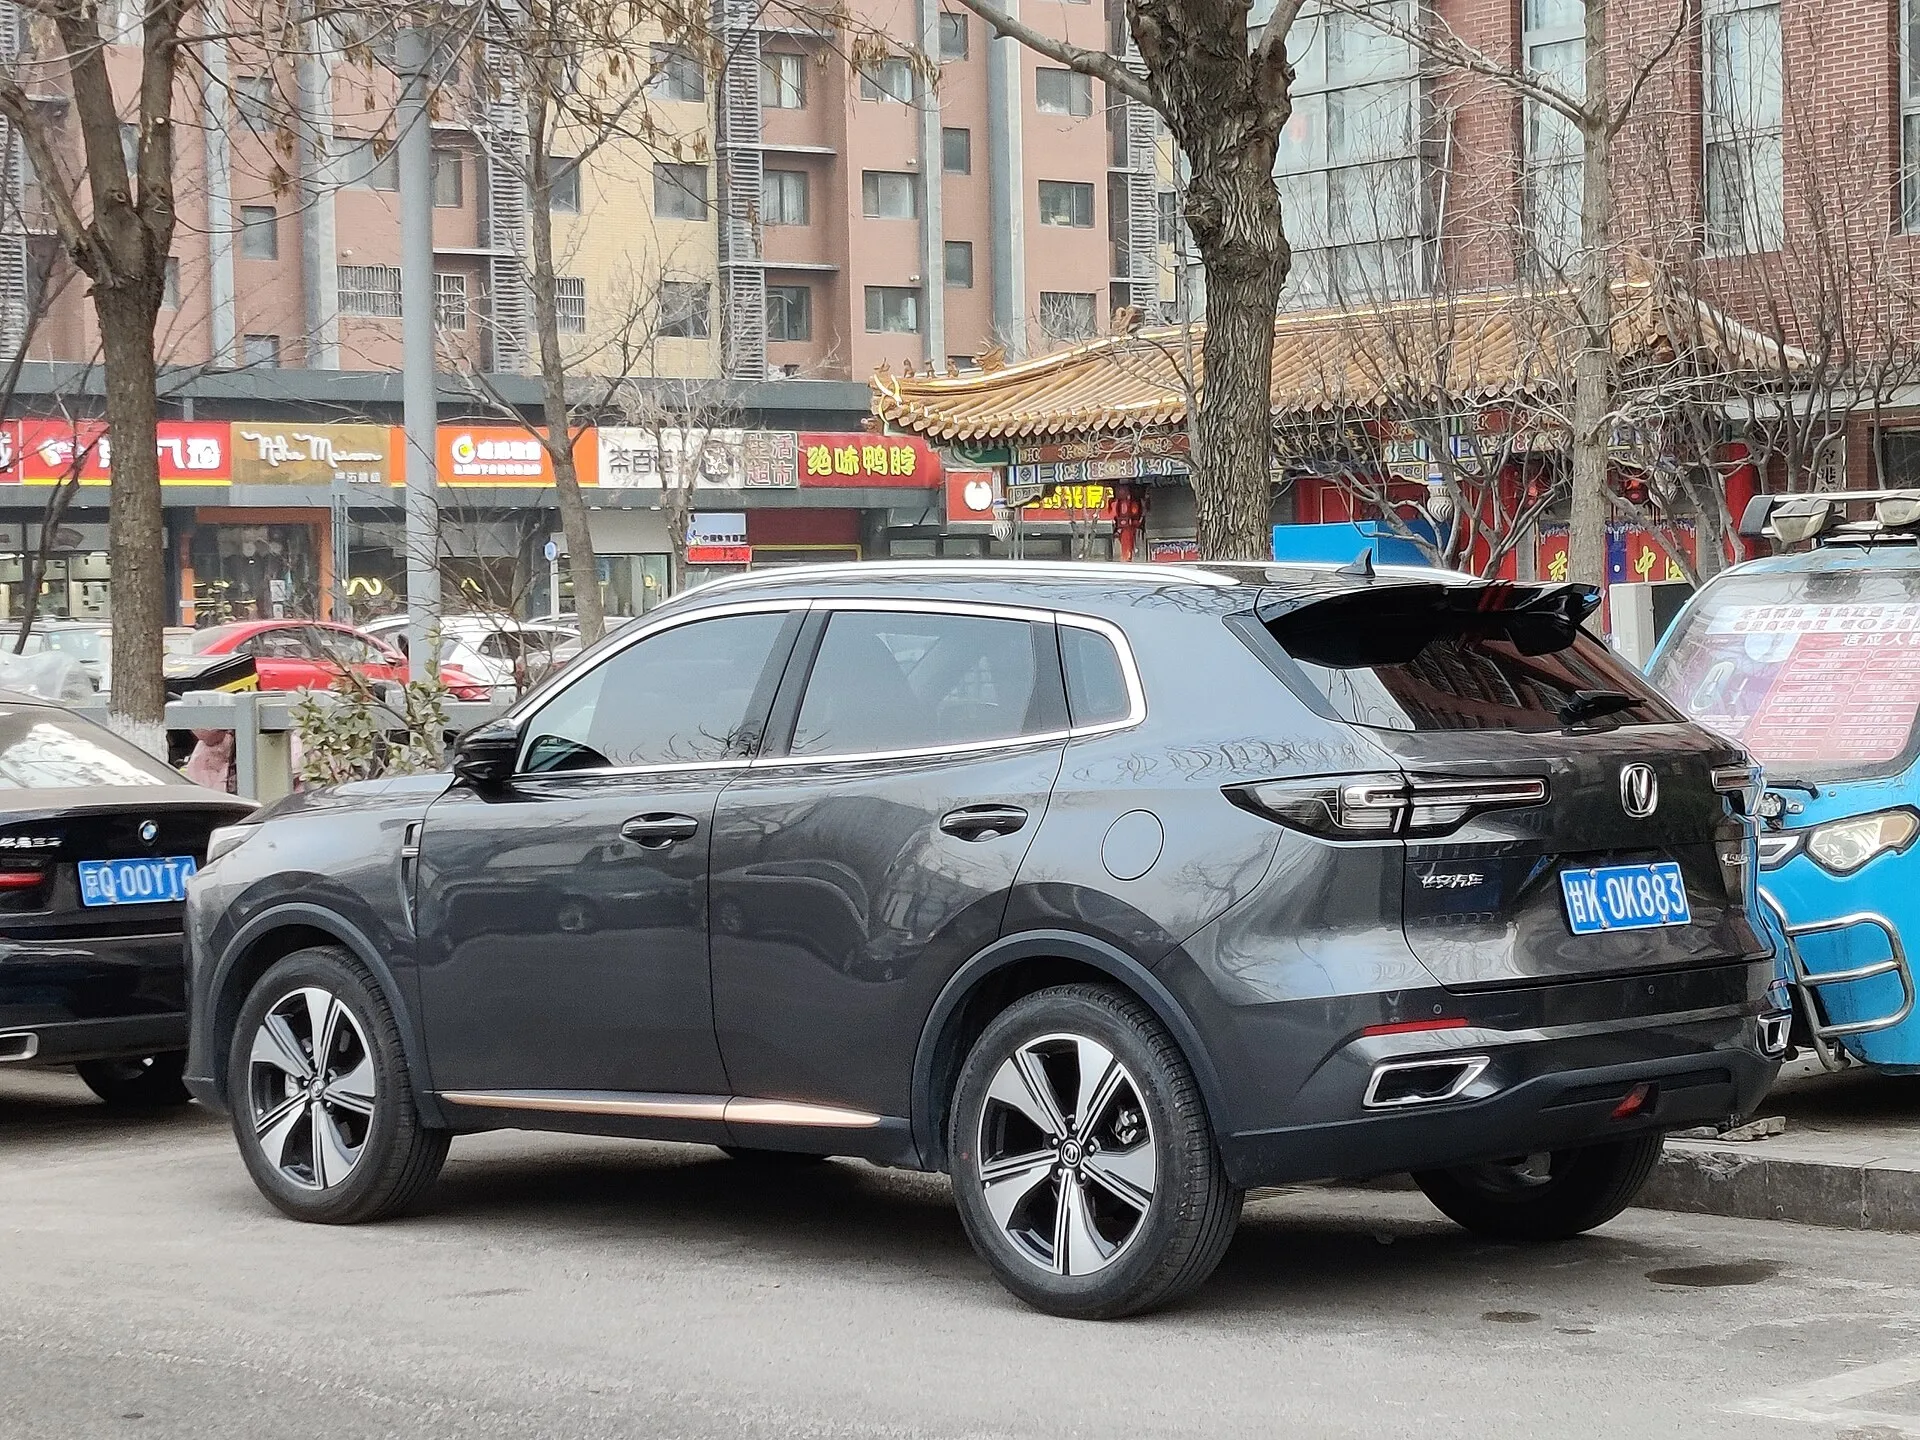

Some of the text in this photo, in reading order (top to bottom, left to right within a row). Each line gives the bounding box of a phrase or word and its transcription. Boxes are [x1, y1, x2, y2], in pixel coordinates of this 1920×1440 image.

[746, 459, 795, 486] 超市
[807, 444, 917, 476] 绝味鸭脖
